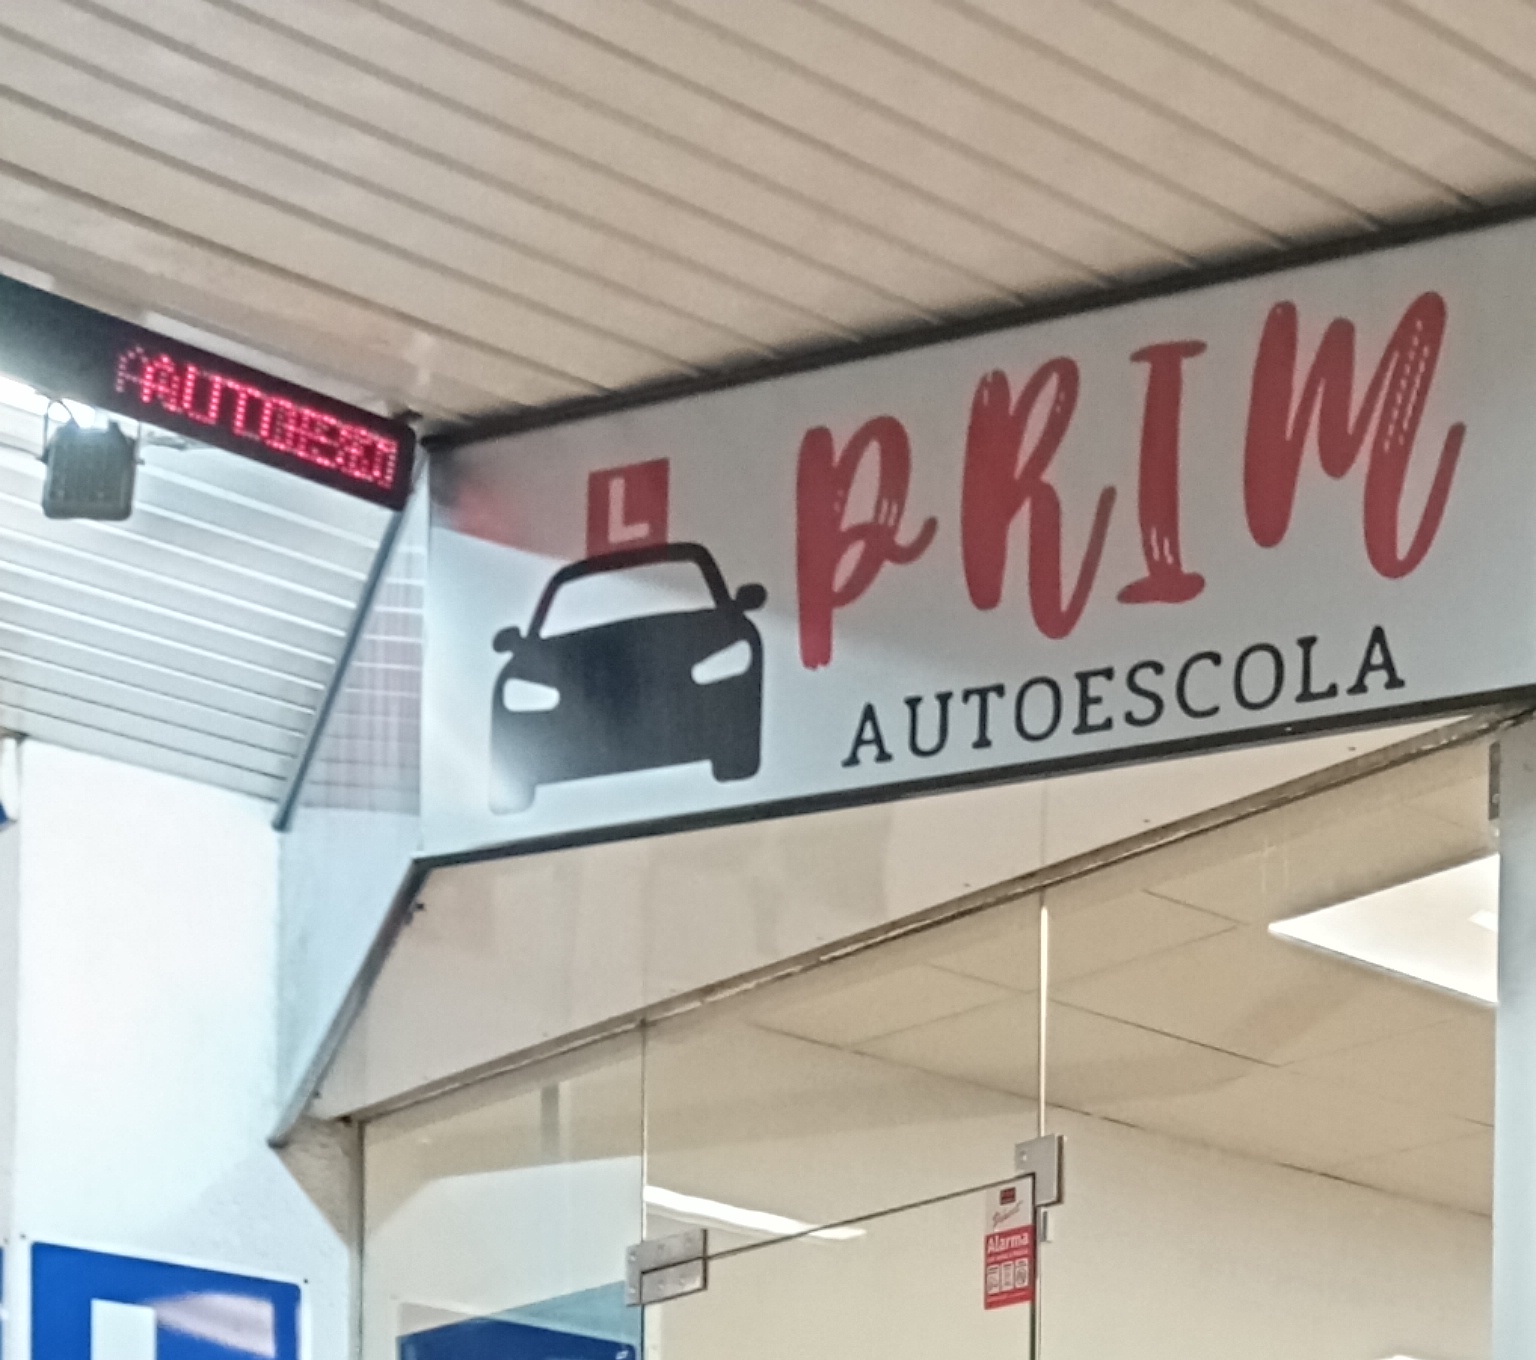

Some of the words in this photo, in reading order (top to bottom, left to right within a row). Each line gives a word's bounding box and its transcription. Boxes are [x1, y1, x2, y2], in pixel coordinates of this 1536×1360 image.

[796, 290, 1467, 670] PRIM
[842, 625, 1405, 768] AUTOESCOLA
[987, 1232, 1029, 1255] Alarma
